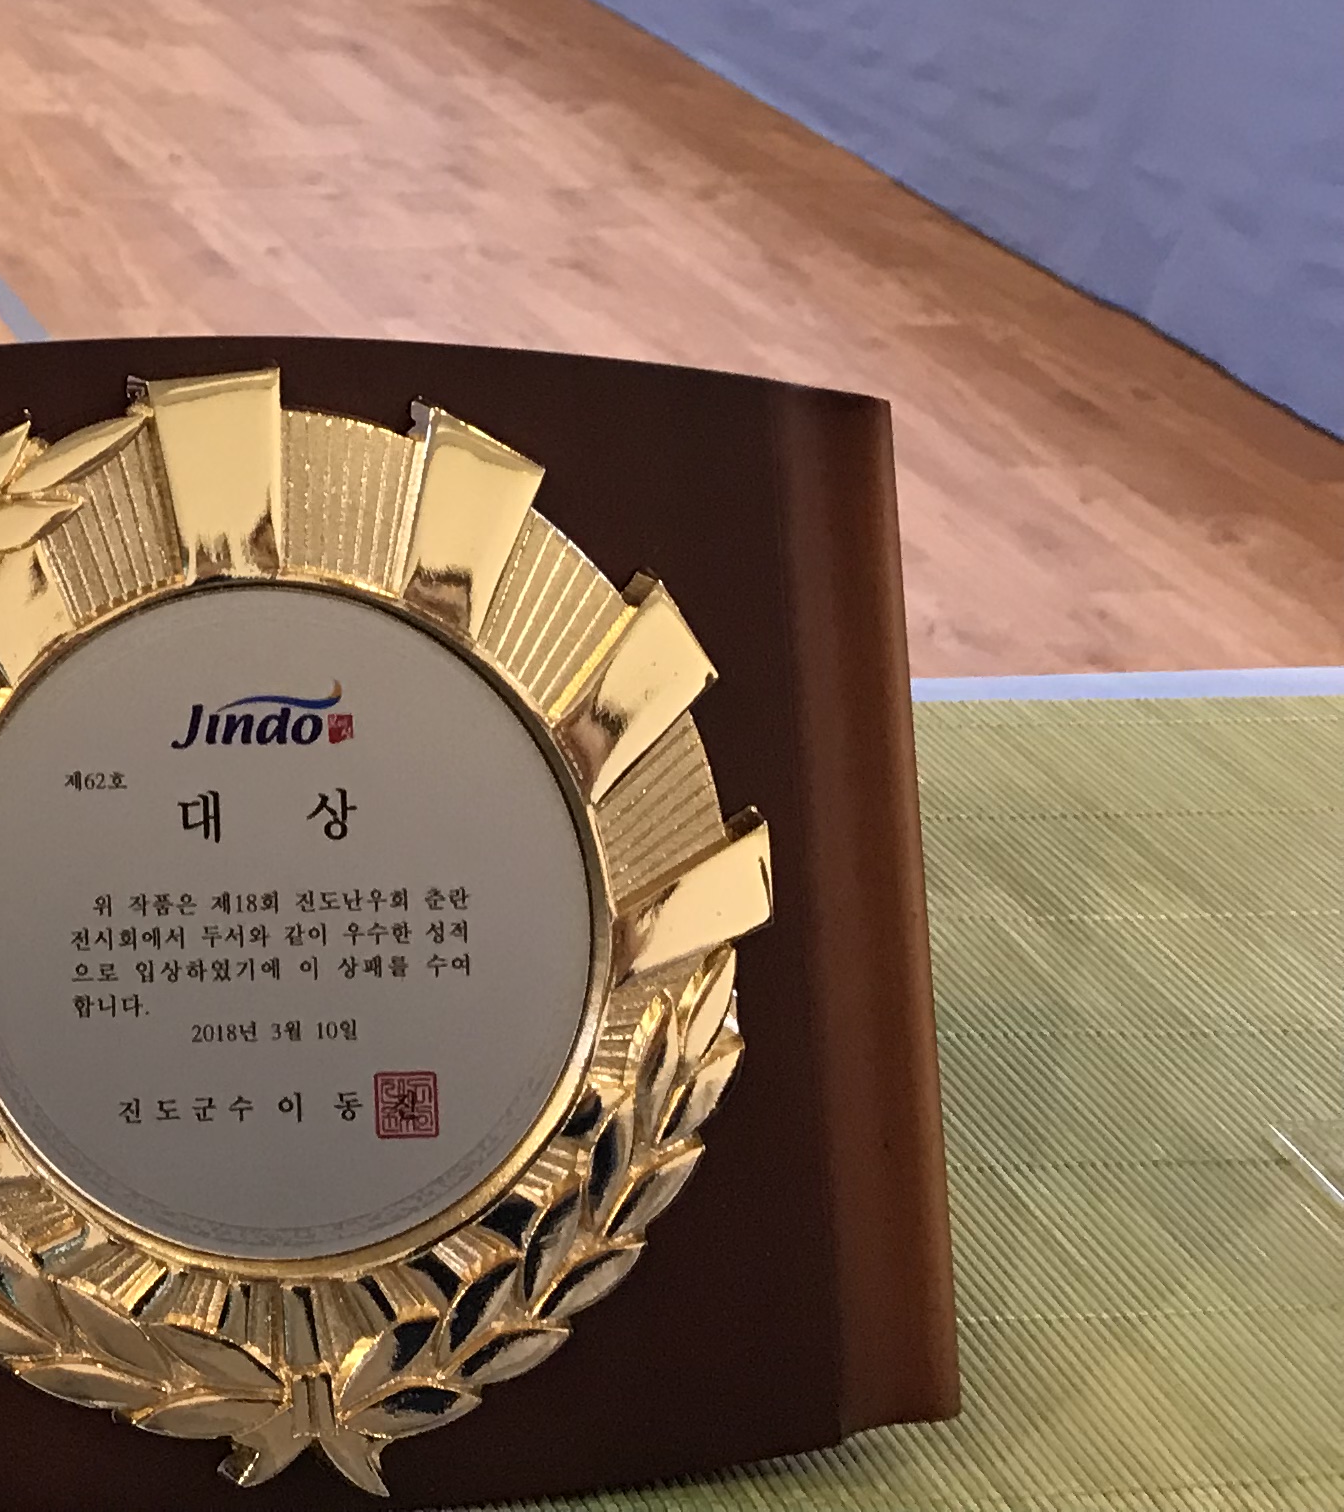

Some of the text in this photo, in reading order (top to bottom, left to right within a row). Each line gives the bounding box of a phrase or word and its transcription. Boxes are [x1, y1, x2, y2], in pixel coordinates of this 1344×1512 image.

[170, 703, 324, 750] Jindo
[64, 770, 128, 792] 제62호
[92, 886, 470, 918] 위 작품은 제18회 진도난우회 춘란
[70, 919, 468, 952] 전시회에서 두서와 같이 우수한 성적
[71, 953, 471, 984] 으로 입상하였기에 이 상패를 수여
[72, 993, 150, 1019] 합니다.
[191, 1018, 358, 1043] 2018년 3월 10일
[118, 1094, 254, 1125] 진도군수
